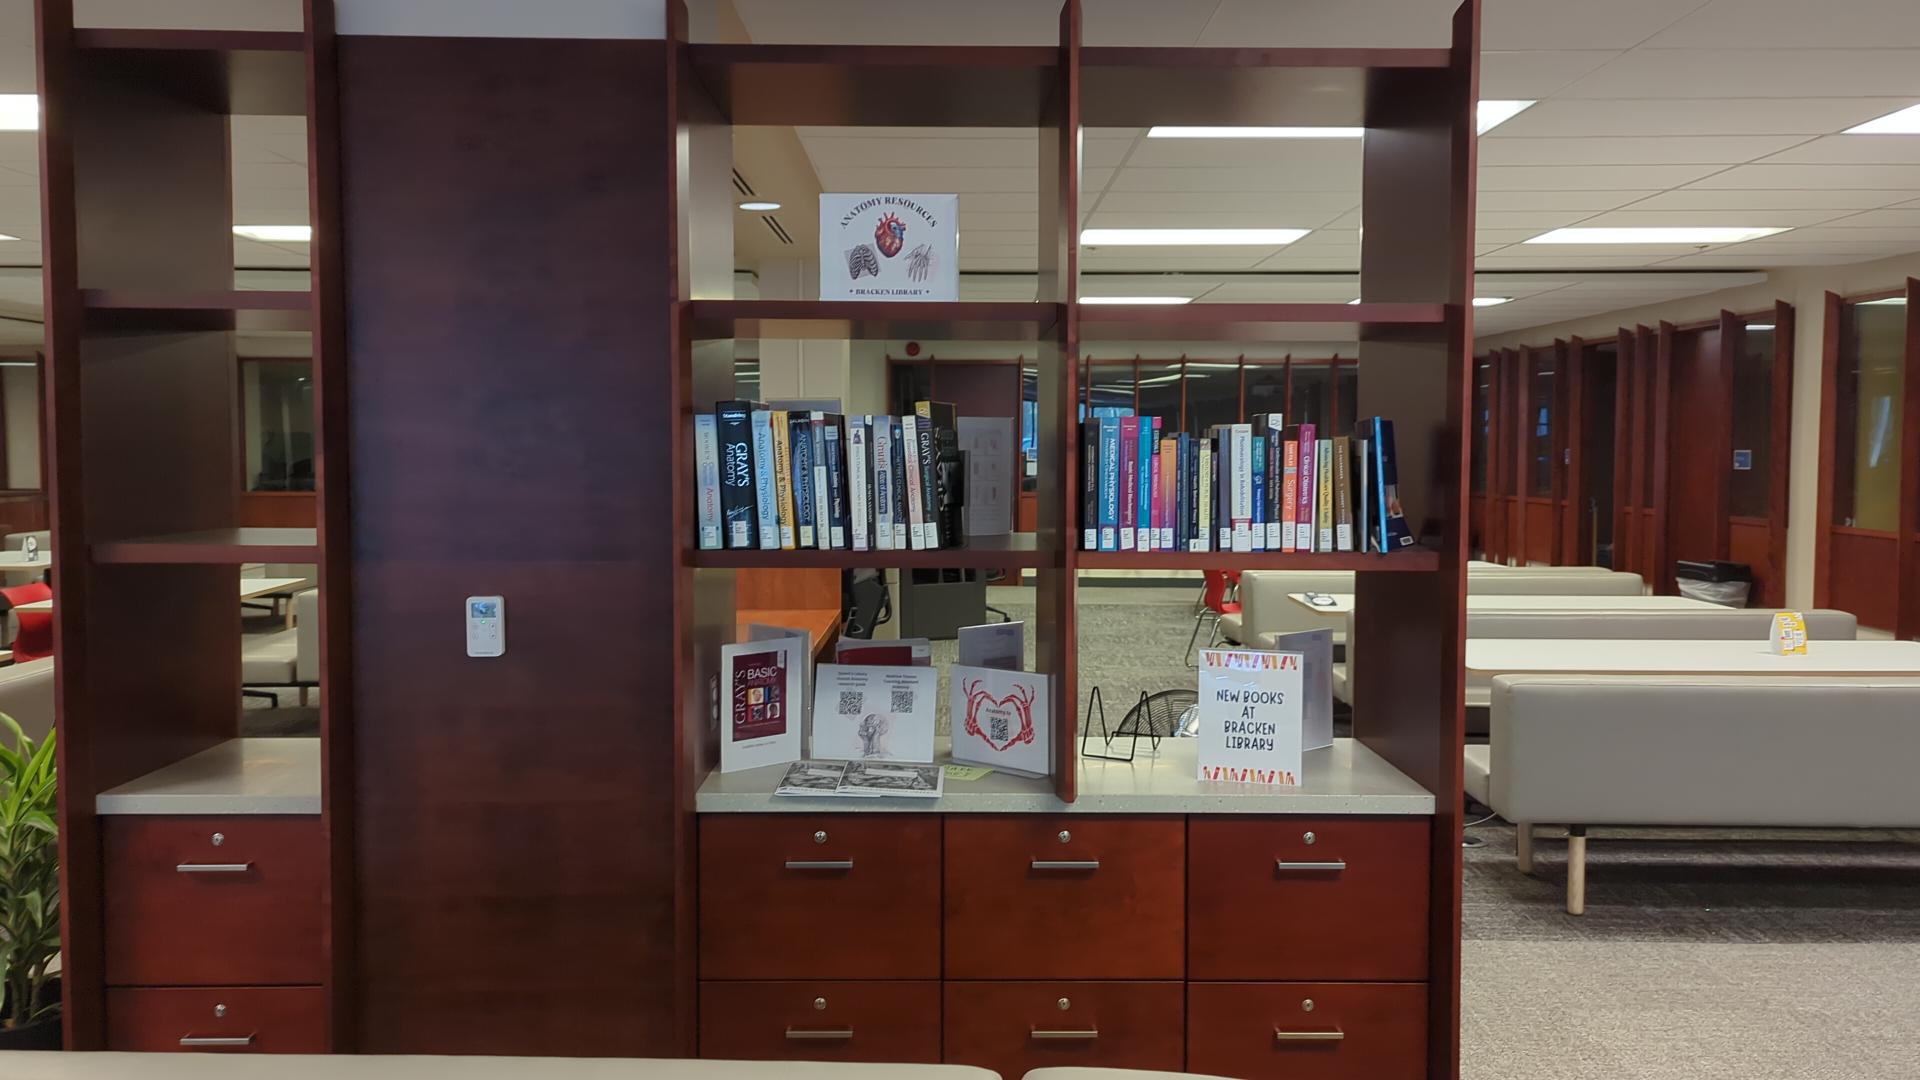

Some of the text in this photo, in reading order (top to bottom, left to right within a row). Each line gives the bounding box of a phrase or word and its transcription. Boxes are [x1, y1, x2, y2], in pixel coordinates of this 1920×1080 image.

[841, 197, 937, 229] ANATOMY RESOURCES
[725, 443, 736, 486] Anatomy
[736, 443, 750, 486] GRAY'S
[758, 432, 767, 469] Anatomy
[799, 434, 807, 469] ANATOMY
[877, 436, 886, 469] Grant's
[921, 432, 931, 465] GRAY'S
[760, 477, 770, 520] Physiology
[776, 440, 784, 474] Anatomy
[780, 485, 788, 526] Physiology
[801, 476, 810, 521] PHYSIOLOGY
[1286, 480, 1295, 510] Surgery
[747, 666, 777, 679] BASIC
[735, 670, 745, 724] GRAY'S
[1216, 689, 1285, 704] NEW BOOKS
[1241, 706, 1255, 719] AT
[1224, 720, 1275, 735] BRACKEN
[1226, 736, 1274, 751] LIBRARY
